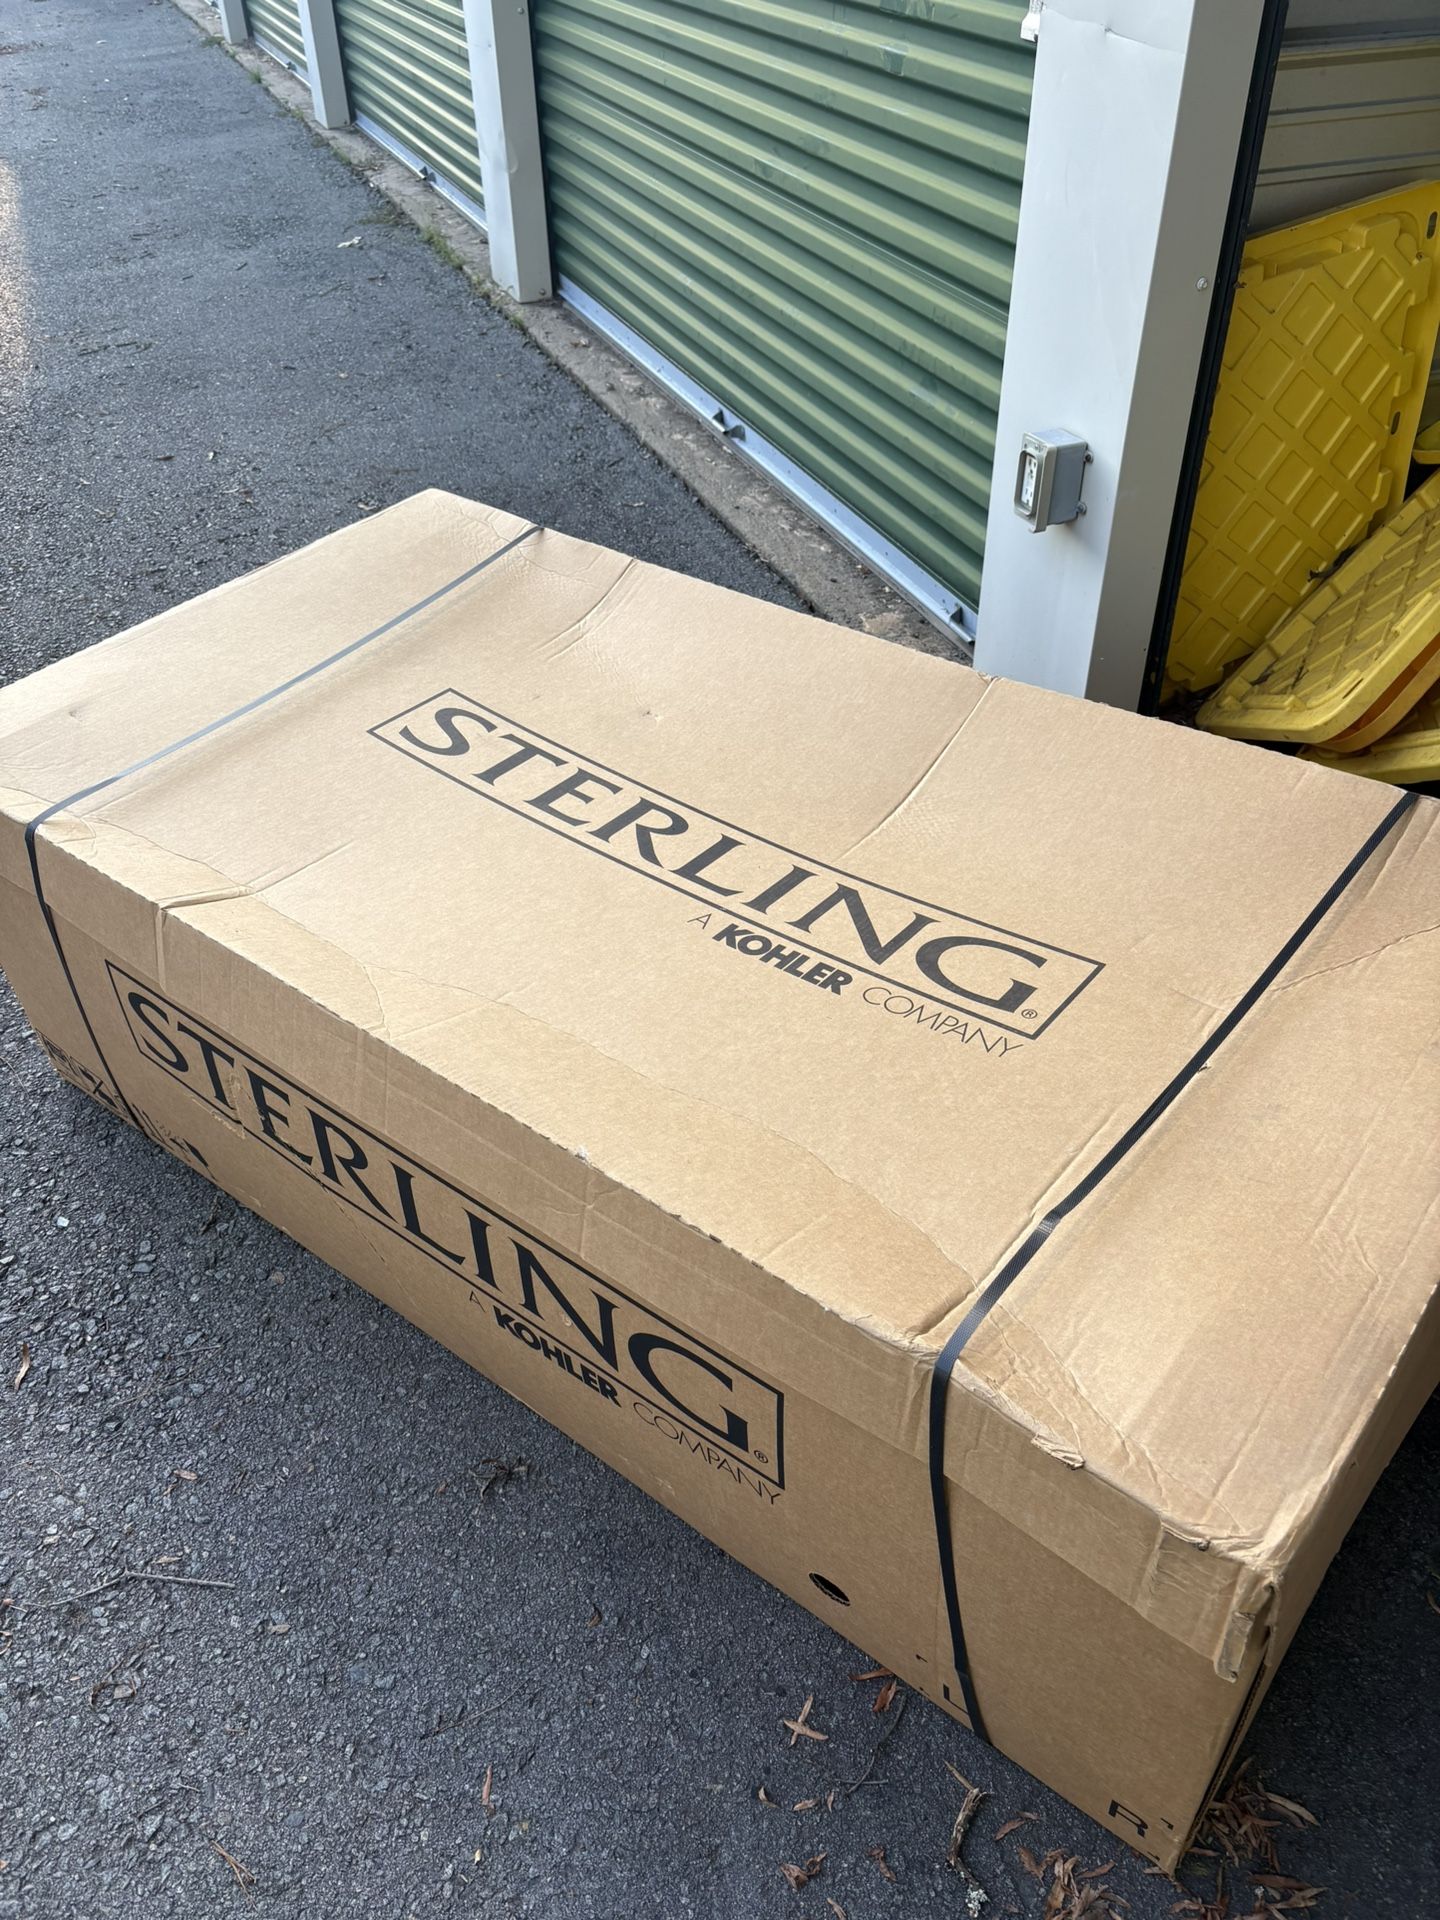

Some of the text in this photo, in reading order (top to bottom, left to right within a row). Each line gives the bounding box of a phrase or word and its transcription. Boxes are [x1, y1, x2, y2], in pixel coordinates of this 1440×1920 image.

[686, 912, 1025, 1058] A KOHLER COMPANY
[469, 1290, 782, 1505] A KOHLER COMPANY
